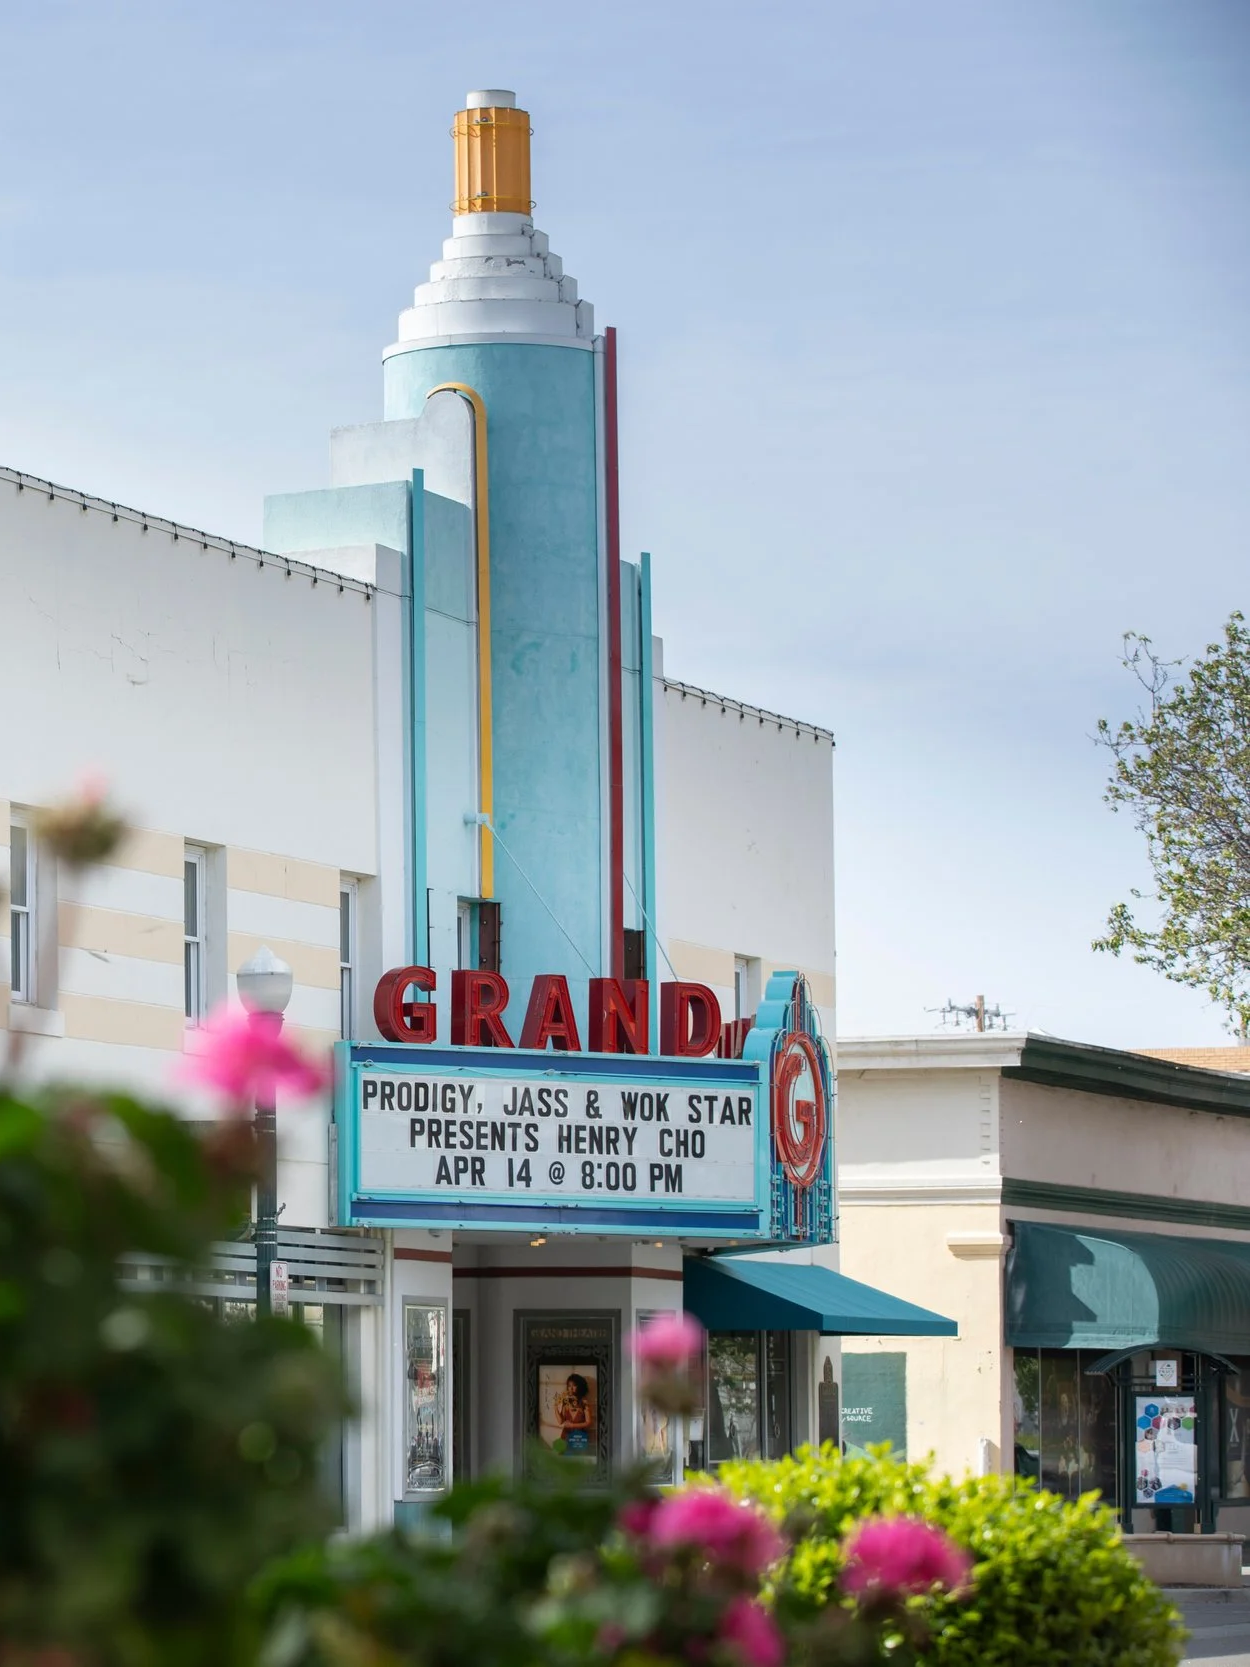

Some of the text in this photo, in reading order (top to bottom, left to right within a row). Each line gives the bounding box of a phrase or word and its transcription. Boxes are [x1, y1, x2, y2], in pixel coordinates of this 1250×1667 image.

[374, 965, 722, 1057] GRAND
[363, 1080, 752, 1125] PRODIGY, JASS & WOK STAR
[410, 1118, 705, 1158] PRESENTS HENRY CHO
[435, 1155, 683, 1193] APR 14 @ 8:00 PM
